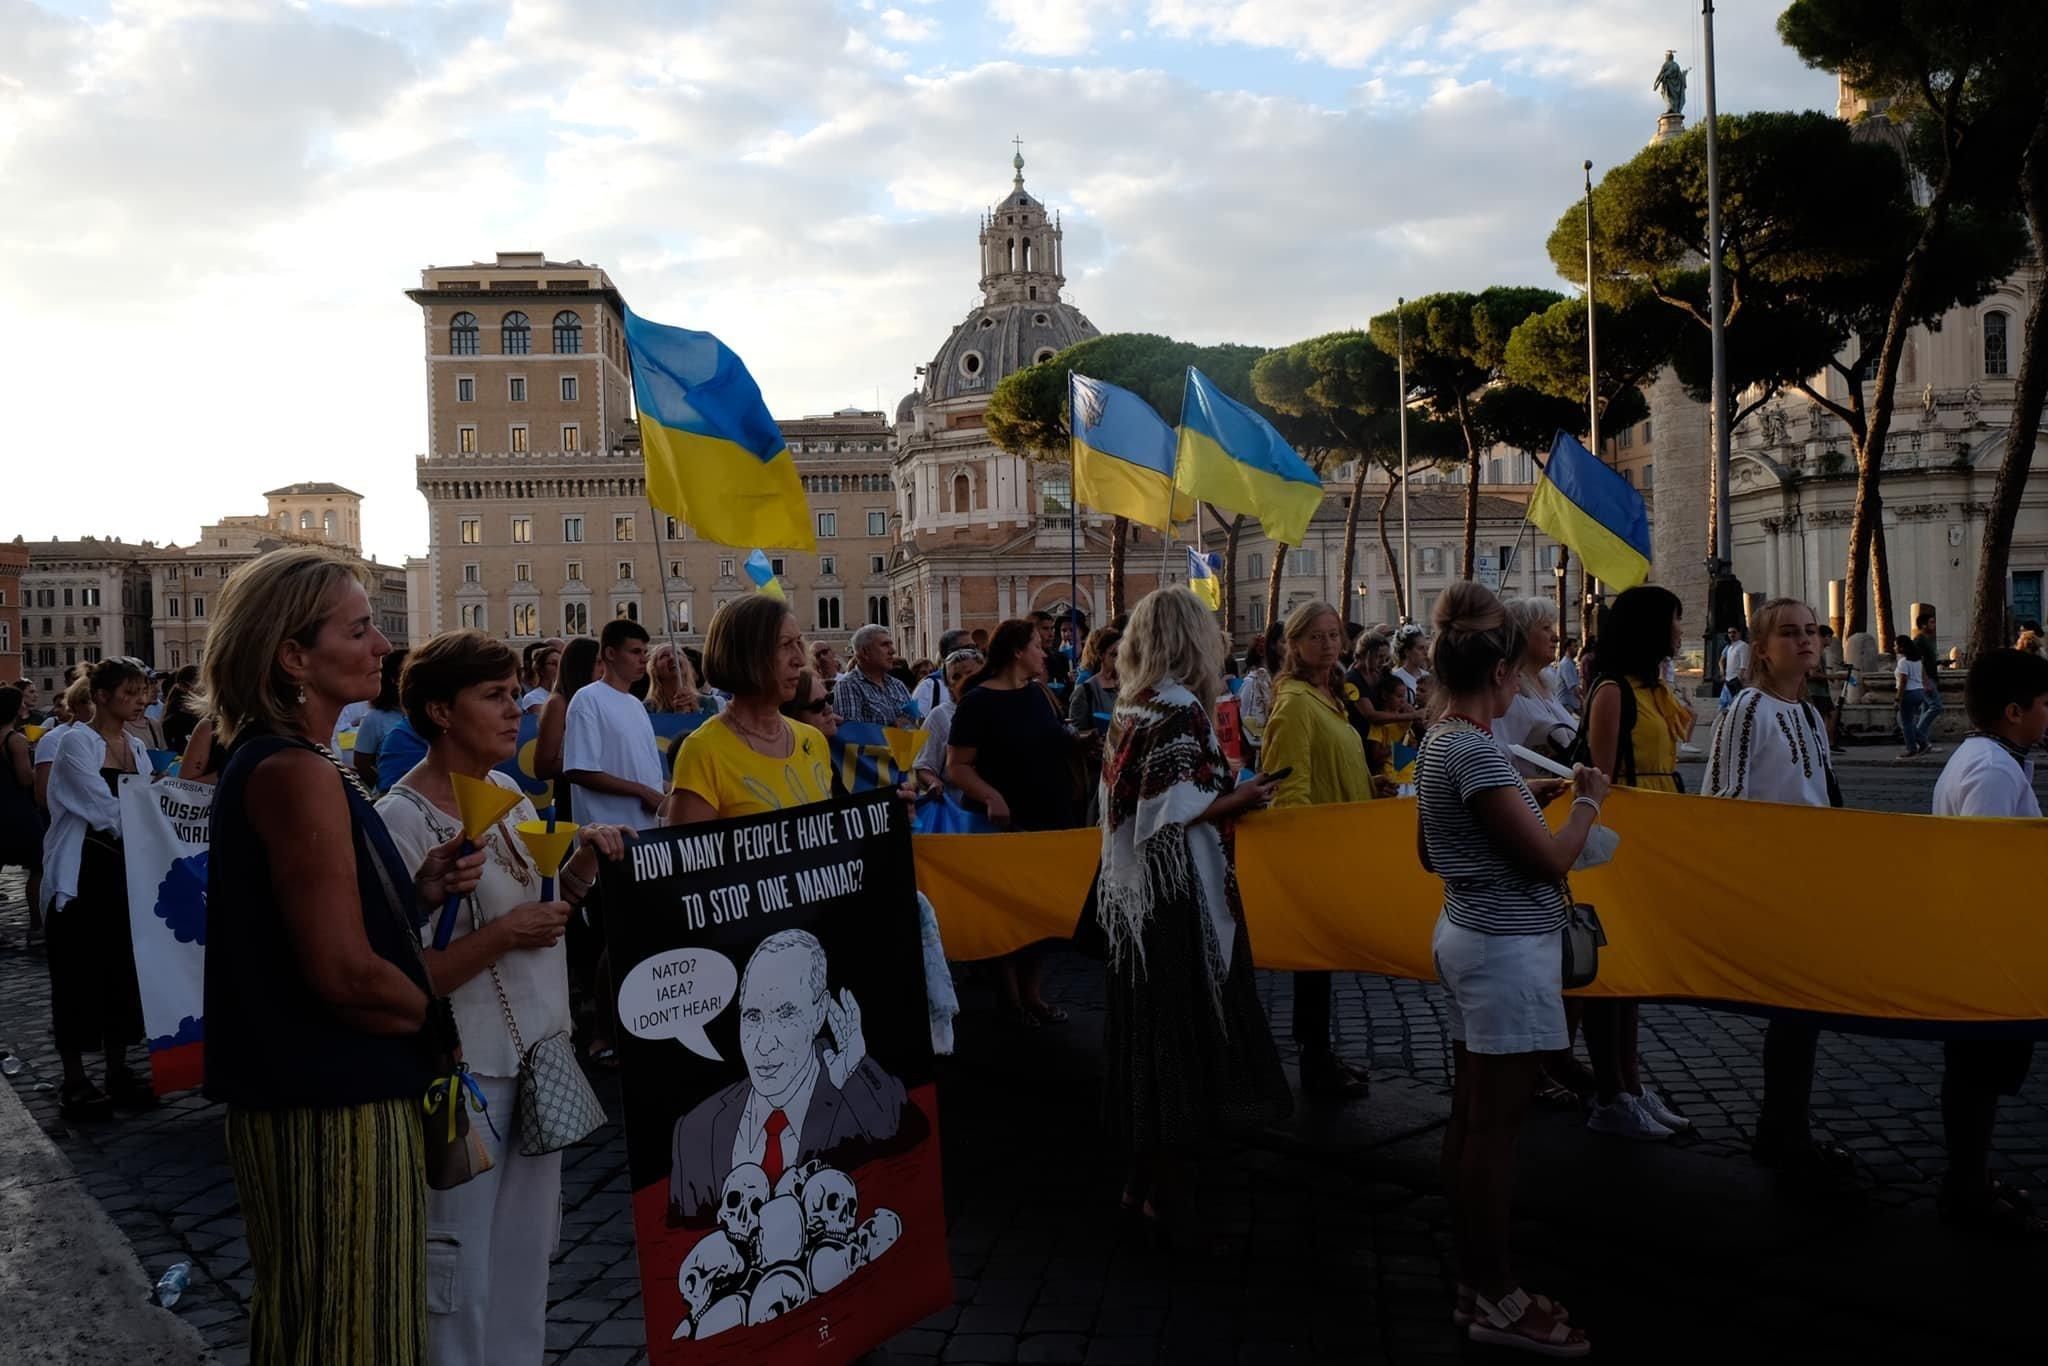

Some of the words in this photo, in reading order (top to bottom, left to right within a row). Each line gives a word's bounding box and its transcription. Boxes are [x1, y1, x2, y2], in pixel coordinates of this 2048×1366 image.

[632, 840, 674, 882] HOW
[677, 831, 726, 873] MANY
[733, 820, 792, 863] PEOPLE
[796, 812, 838, 851] HAVE
[841, 807, 865, 841] TO
[867, 801, 891, 837] DIE
[681, 893, 706, 931] TO
[709, 884, 751, 925] STOP
[757, 875, 793, 913] ONE
[795, 858, 864, 905] MANIAC?
[652, 958, 696, 980] NATO?
[657, 980, 693, 1002] IAEA?
[633, 1017, 637, 1032] I
[640, 1006, 679, 1030] DON'T
[683, 996, 722, 1017] HEAR!
